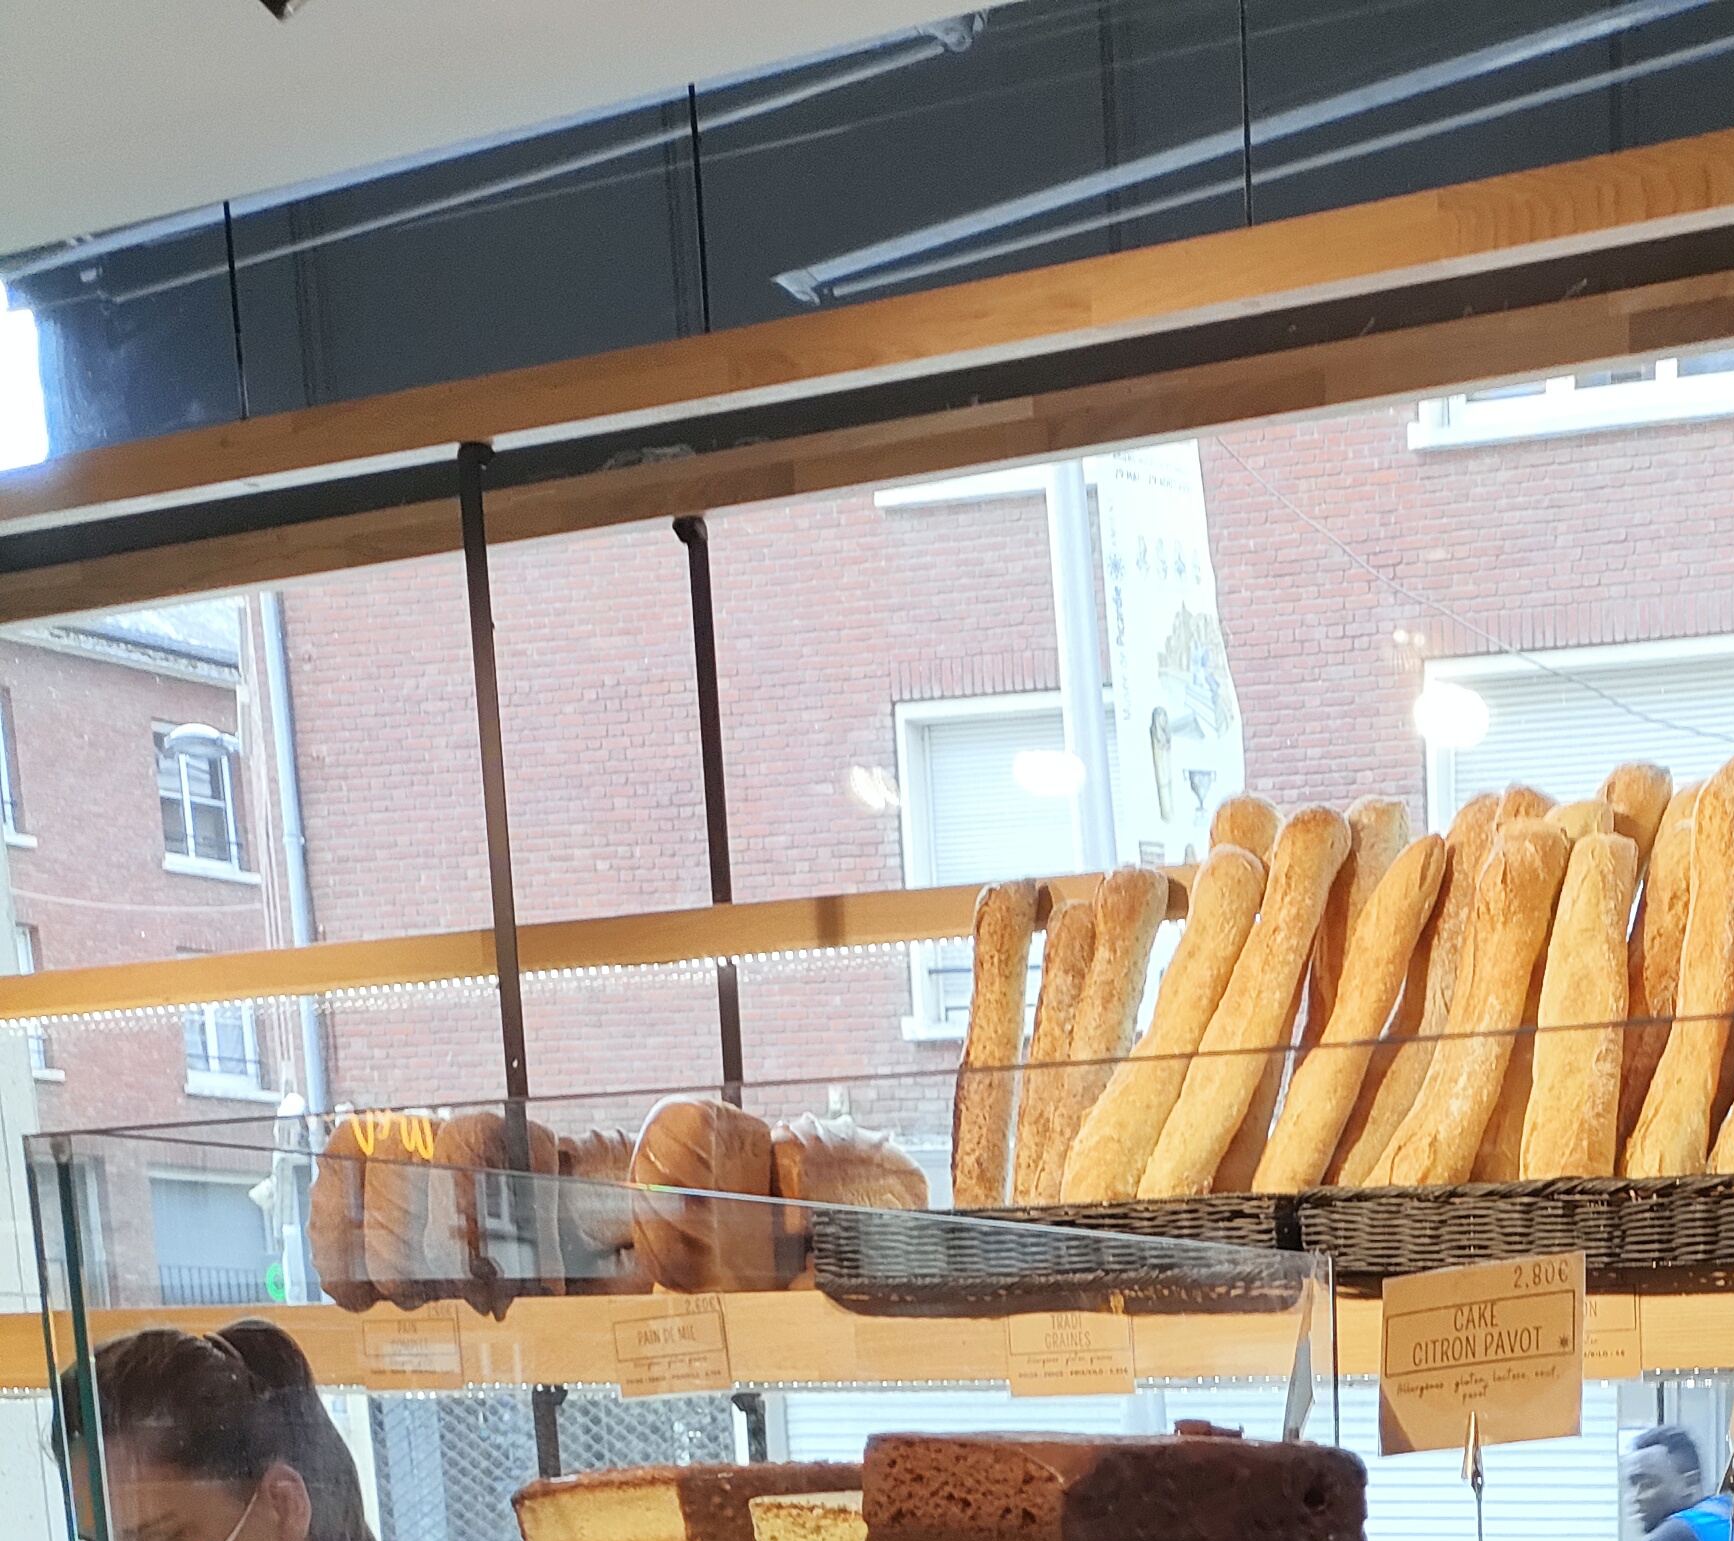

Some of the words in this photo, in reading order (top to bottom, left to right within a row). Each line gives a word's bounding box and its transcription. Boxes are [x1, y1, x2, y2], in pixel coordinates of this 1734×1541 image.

[1454, 1302, 1499, 1332] CAKE
[637, 1329, 661, 1345] PAIN
[1045, 1331, 1091, 1349] GRAINES
[1413, 1335, 1476, 1366] CITRON
[1484, 1326, 1543, 1357] PAVOT
